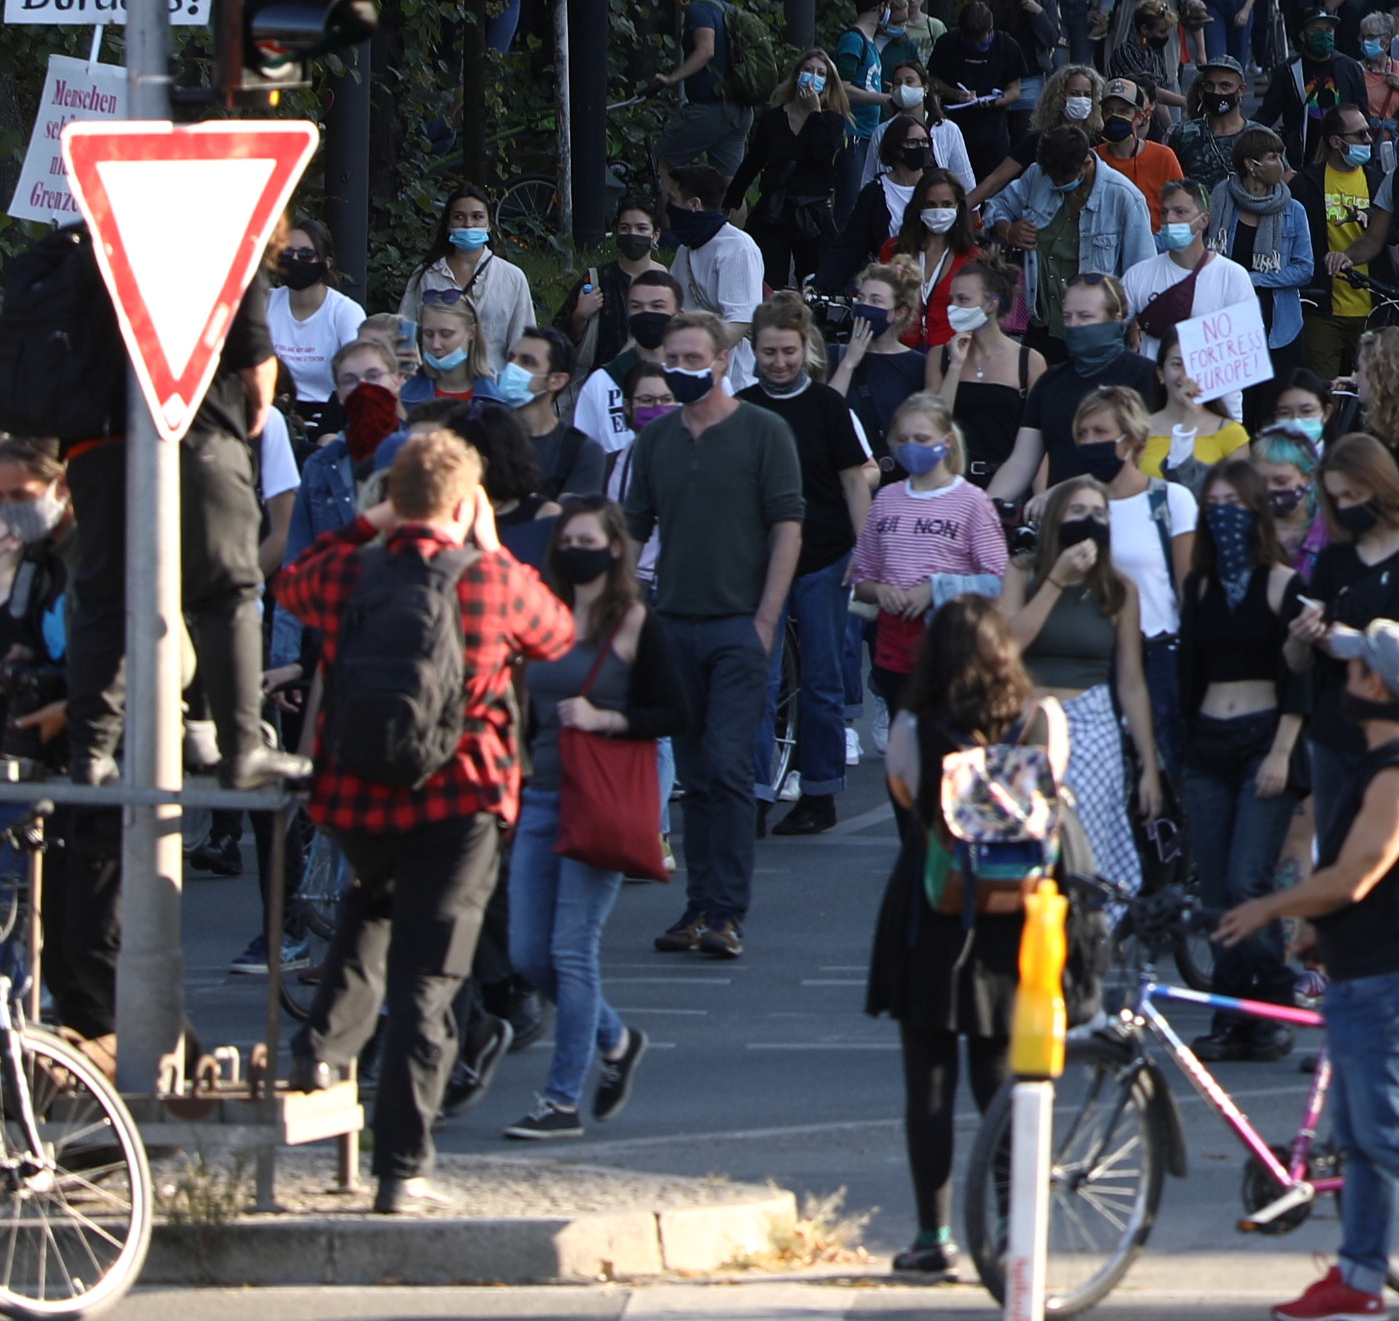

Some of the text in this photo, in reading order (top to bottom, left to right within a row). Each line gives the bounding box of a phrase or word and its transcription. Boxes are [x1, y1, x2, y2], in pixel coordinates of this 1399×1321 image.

[51, 79, 118, 115] Menschen
[30, 181, 81, 213] Grenze
[1202, 313, 1232, 344] NO
[1189, 330, 1263, 370] FORTRESS
[1195, 354, 1259, 394] EUROPE!
[913, 517, 960, 540] NON
